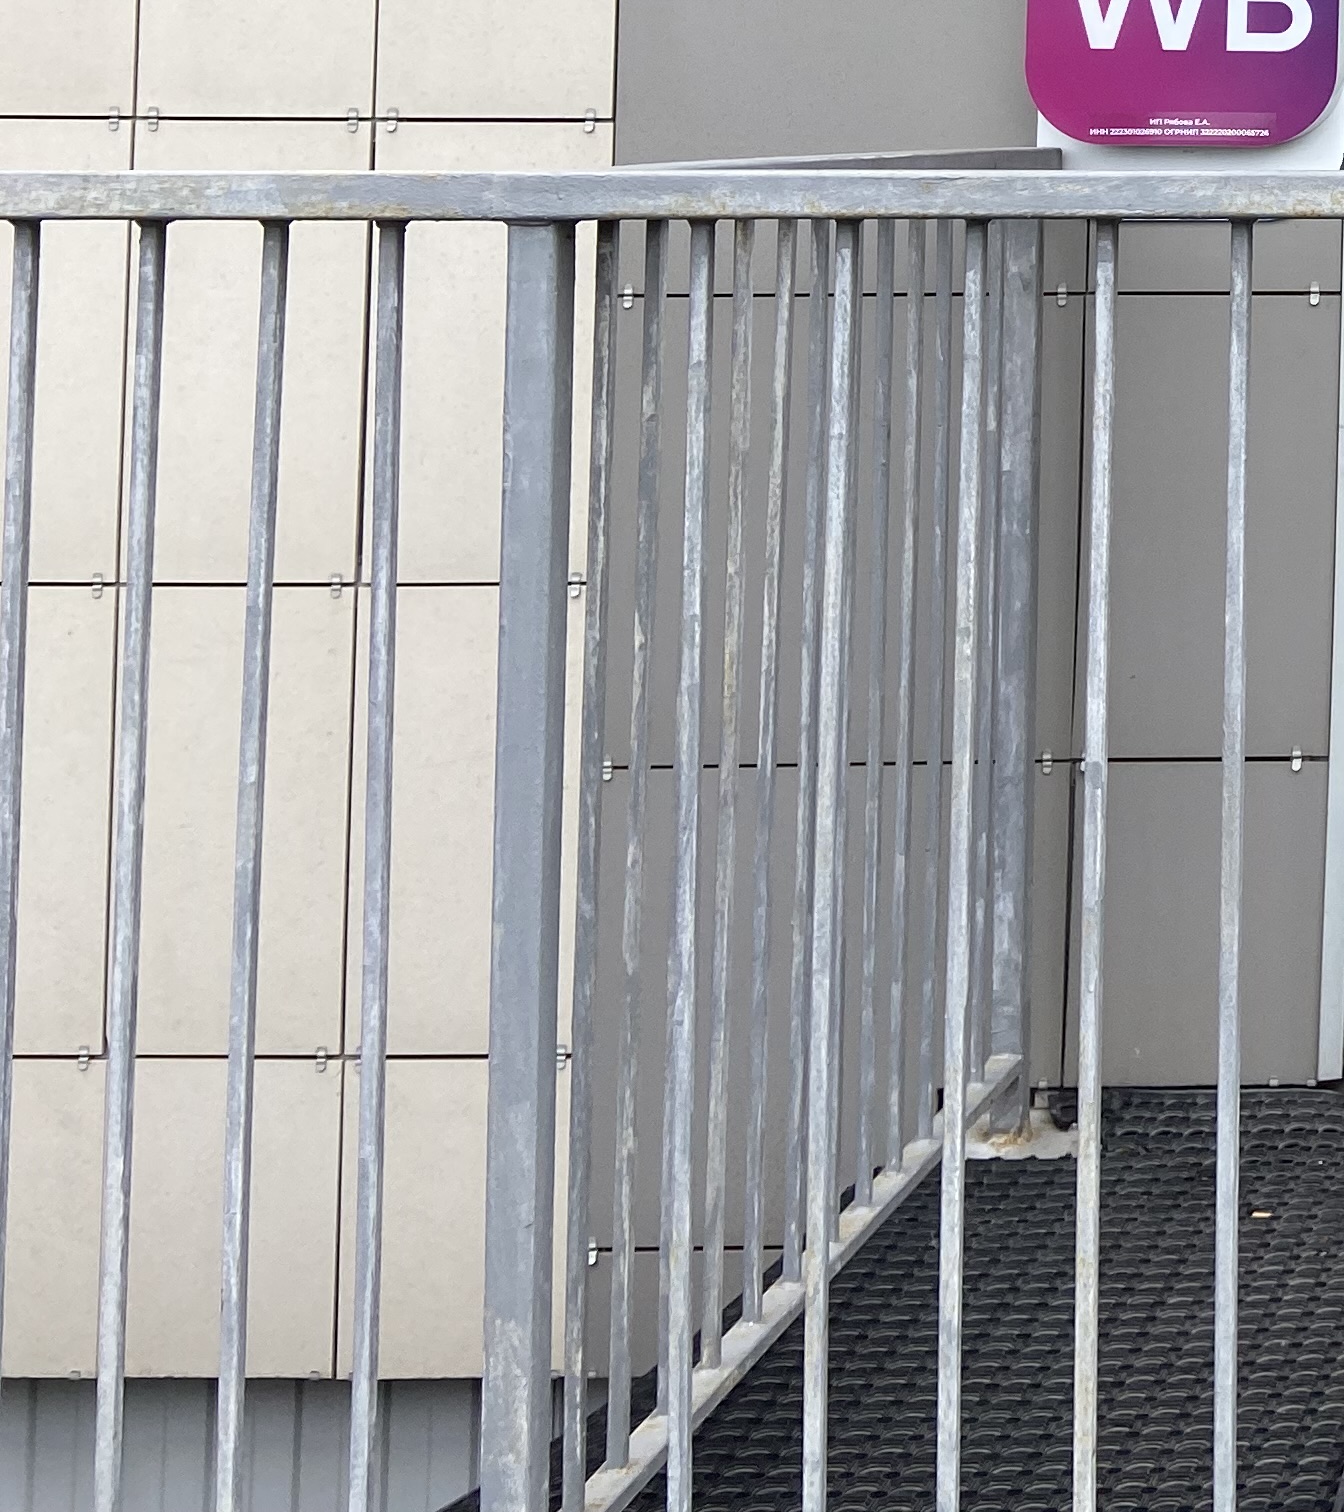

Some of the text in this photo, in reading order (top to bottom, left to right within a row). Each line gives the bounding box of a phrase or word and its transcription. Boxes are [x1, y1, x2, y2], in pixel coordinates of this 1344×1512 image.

[1149, 118, 1163, 126] ИП
[1089, 128, 1109, 136] ИНН
[1163, 128, 1199, 136] ОГРНИП
